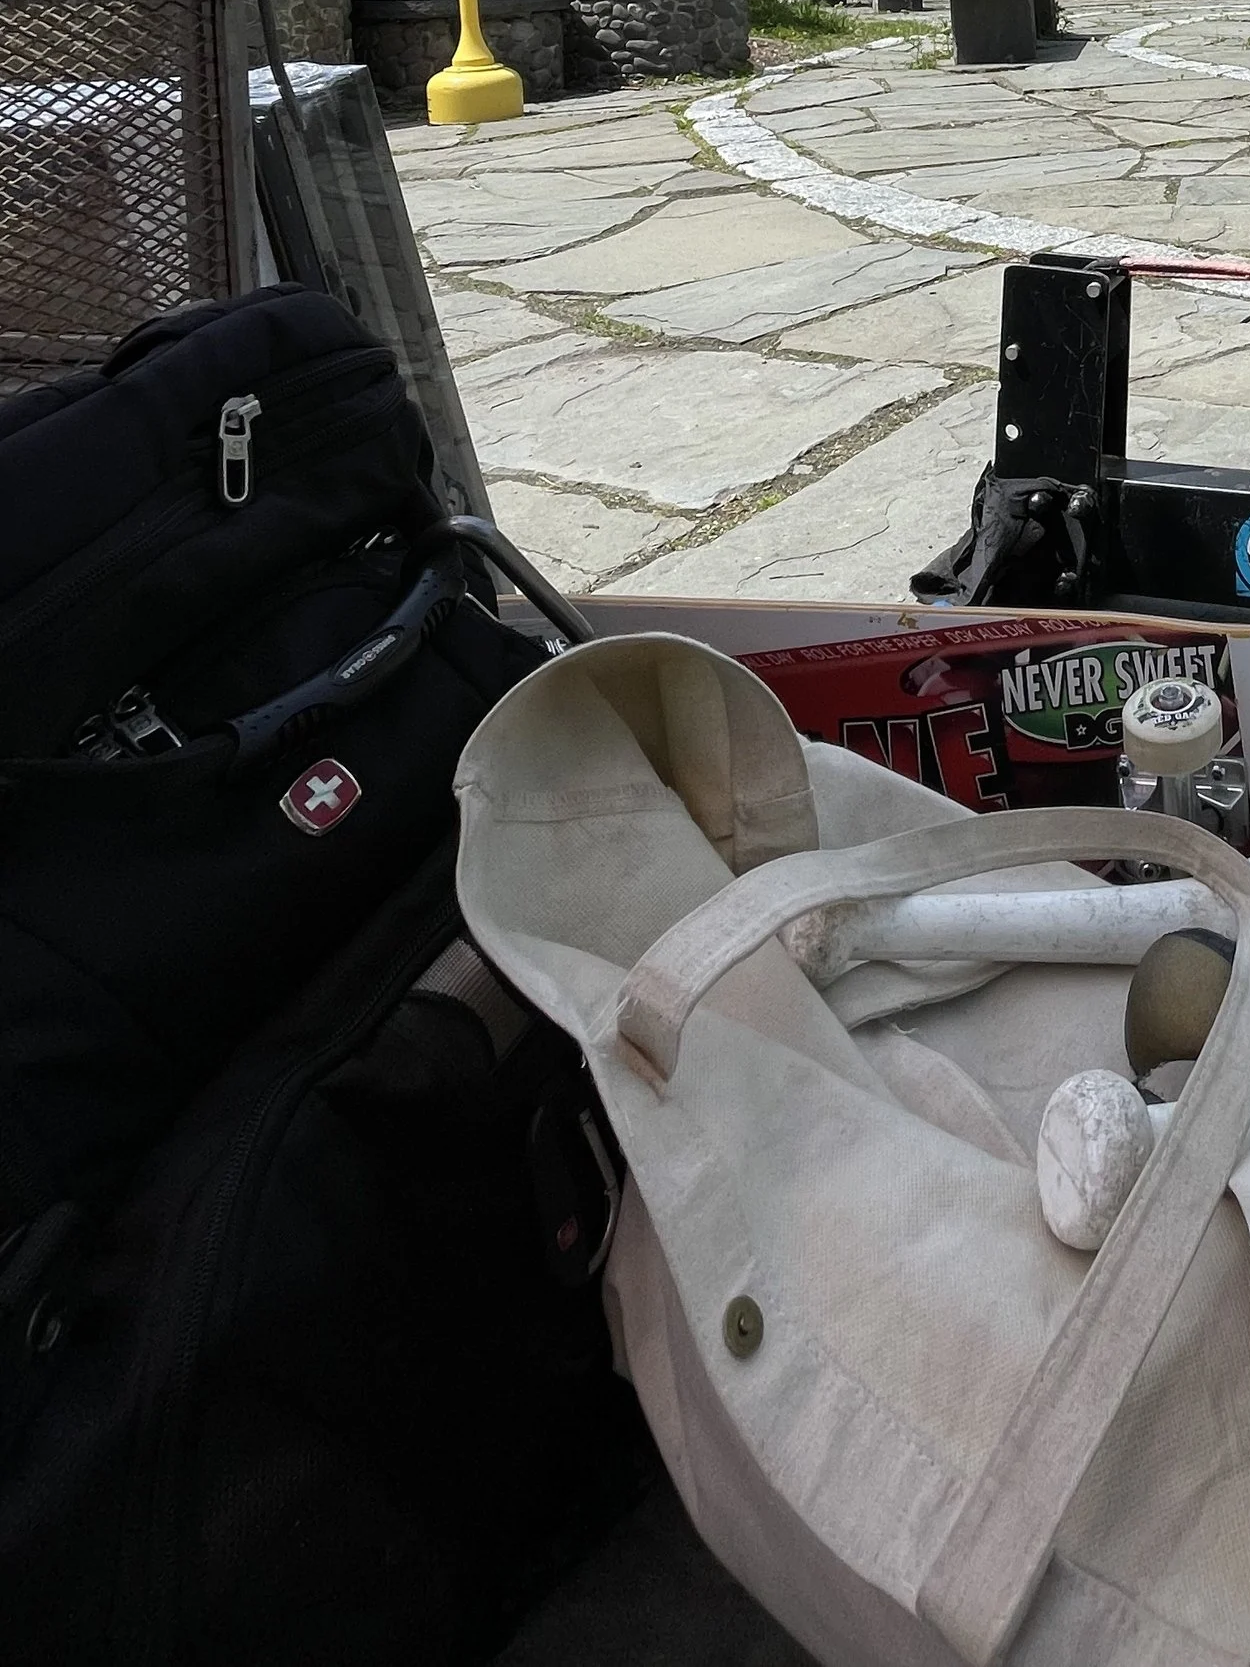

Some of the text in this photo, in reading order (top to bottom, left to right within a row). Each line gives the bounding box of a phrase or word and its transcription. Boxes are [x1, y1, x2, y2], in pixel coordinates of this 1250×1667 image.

[800, 645, 842, 662] ROLL
[836, 641, 869, 657] FOR
[864, 638, 898, 654] THE
[893, 635, 942, 650] PAPER
[944, 631, 981, 644] DGK
[976, 625, 1009, 641] ALL
[1002, 621, 1035, 637] DAY
[1037, 618, 1081, 633] ROLL
[1001, 644, 1217, 715] NEVER SWEET
[1062, 707, 1126, 751] DG
